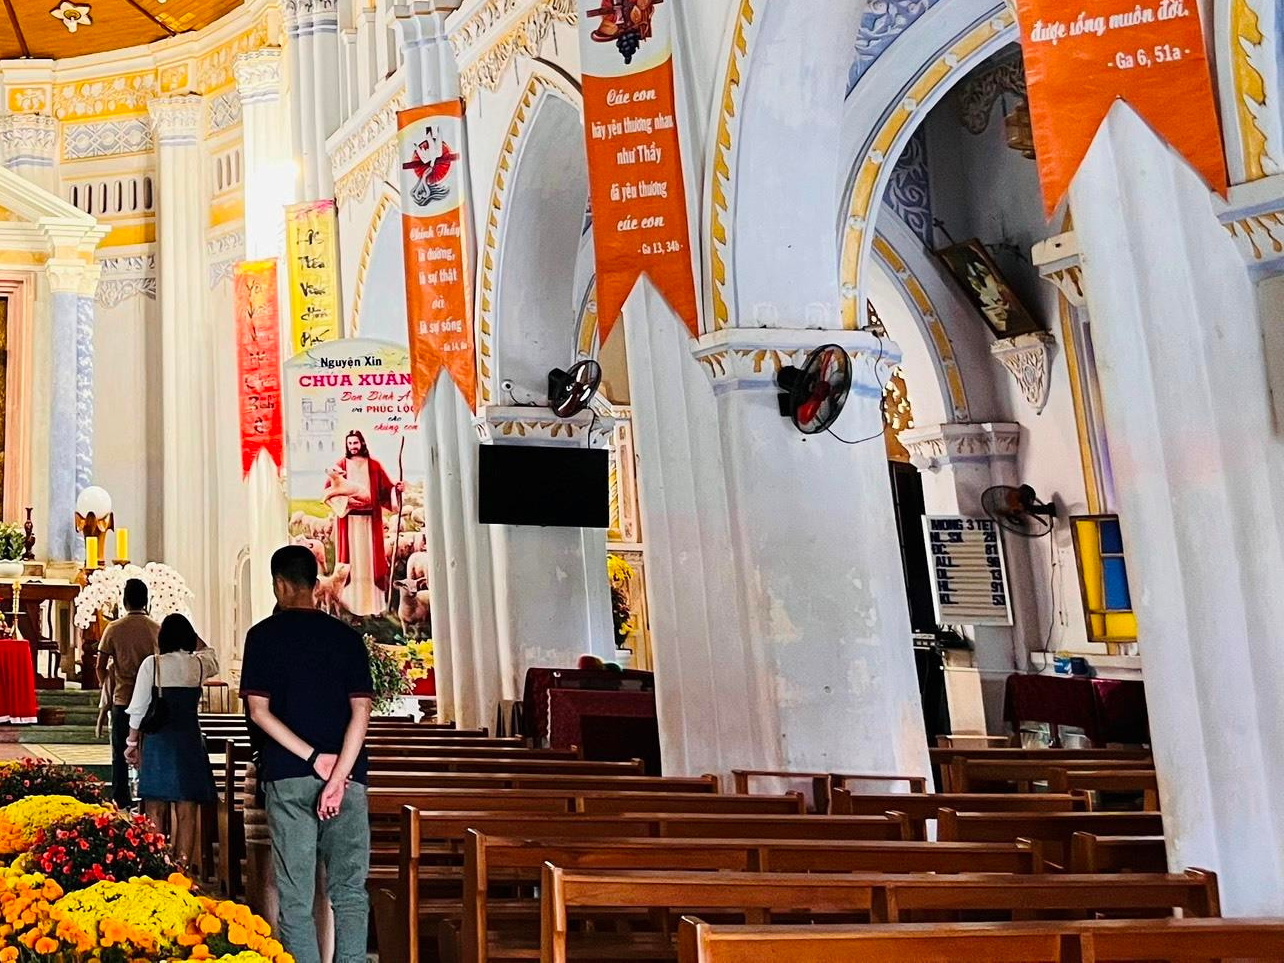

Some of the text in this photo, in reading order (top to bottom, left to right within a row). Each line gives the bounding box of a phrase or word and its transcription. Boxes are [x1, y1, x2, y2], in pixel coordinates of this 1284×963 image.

[1031, 19, 1066, 46] được
[1069, 10, 1106, 37] sống
[1109, 4, 1155, 30] muôn
[1116, 51, 1134, 70] Ga
[1136, 48, 1151, 69] 6,
[1154, 44, 1181, 63] 51a
[607, 89, 656, 106] Các con
[607, 119, 622, 139] yêu
[617, 147, 636, 165] như
[622, 182, 637, 203] yêu
[617, 214, 665, 231] các con
[642, 243, 651, 254] Ga
[321, 356, 382, 370] Nguyện Xin
[299, 371, 413, 387] CHÚA XUÂN
[366, 404, 393, 413] PHÚC
[967, 519, 974, 530] 3
